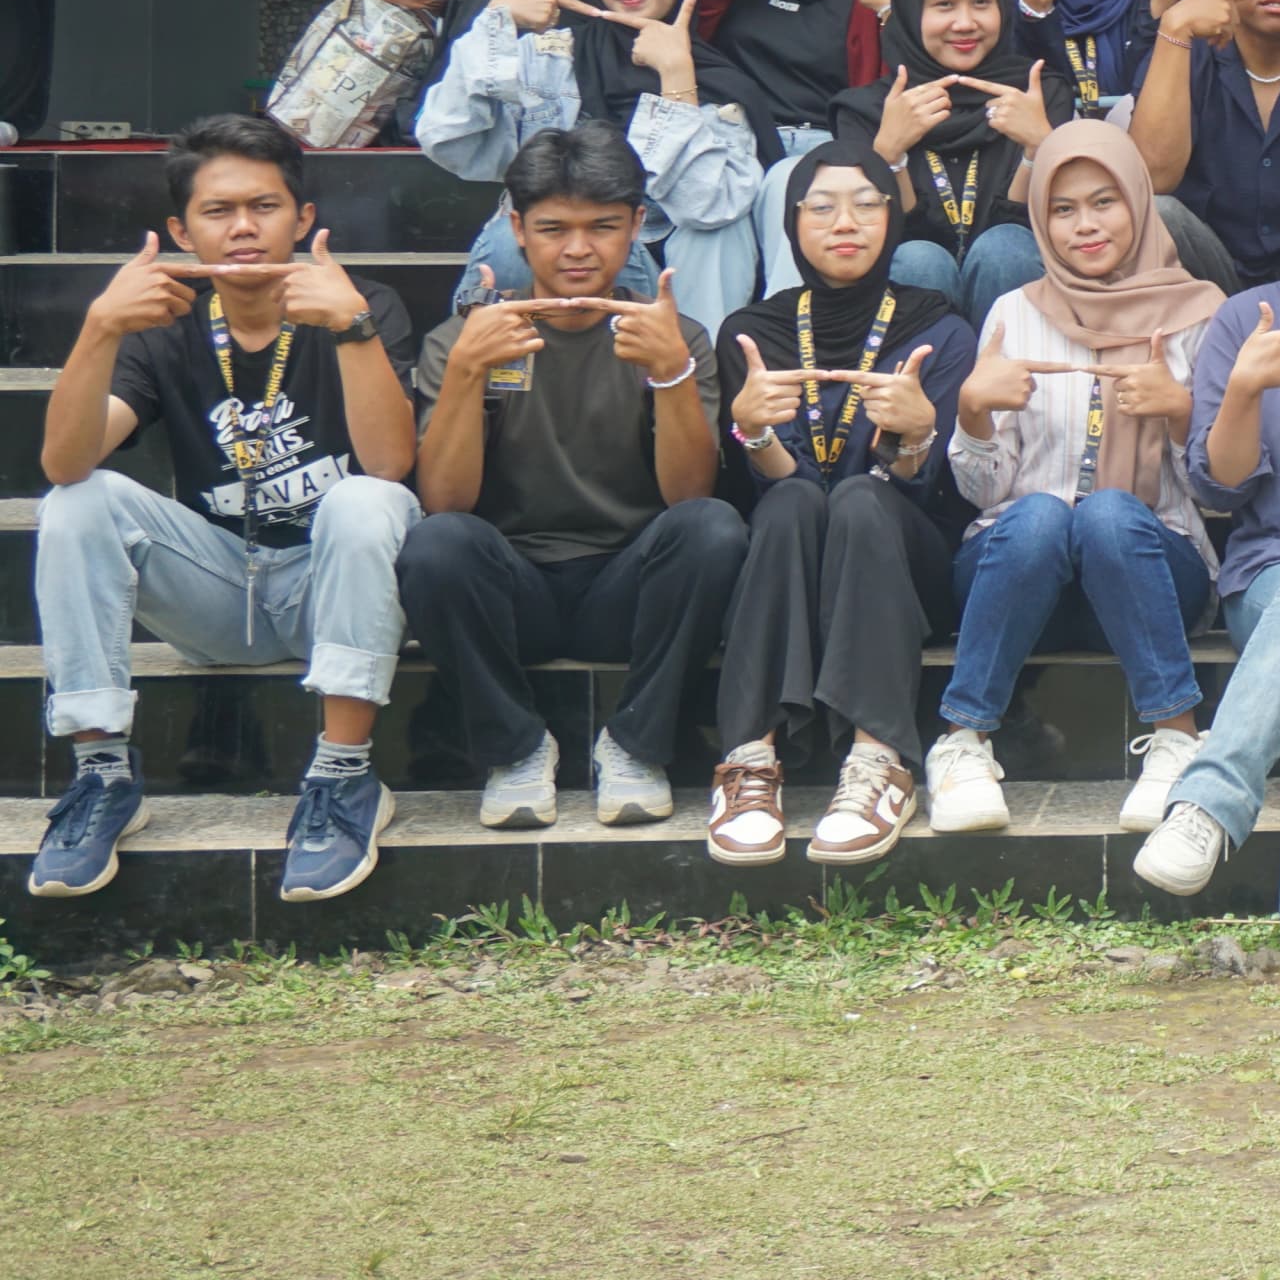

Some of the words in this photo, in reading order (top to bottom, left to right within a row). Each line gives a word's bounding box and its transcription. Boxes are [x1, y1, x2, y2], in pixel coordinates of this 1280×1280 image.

[275, 331, 294, 364] HMTI
[799, 330, 815, 358] HMTI
[264, 363, 288, 407] UDINUS
[241, 472, 318, 508] AVA
